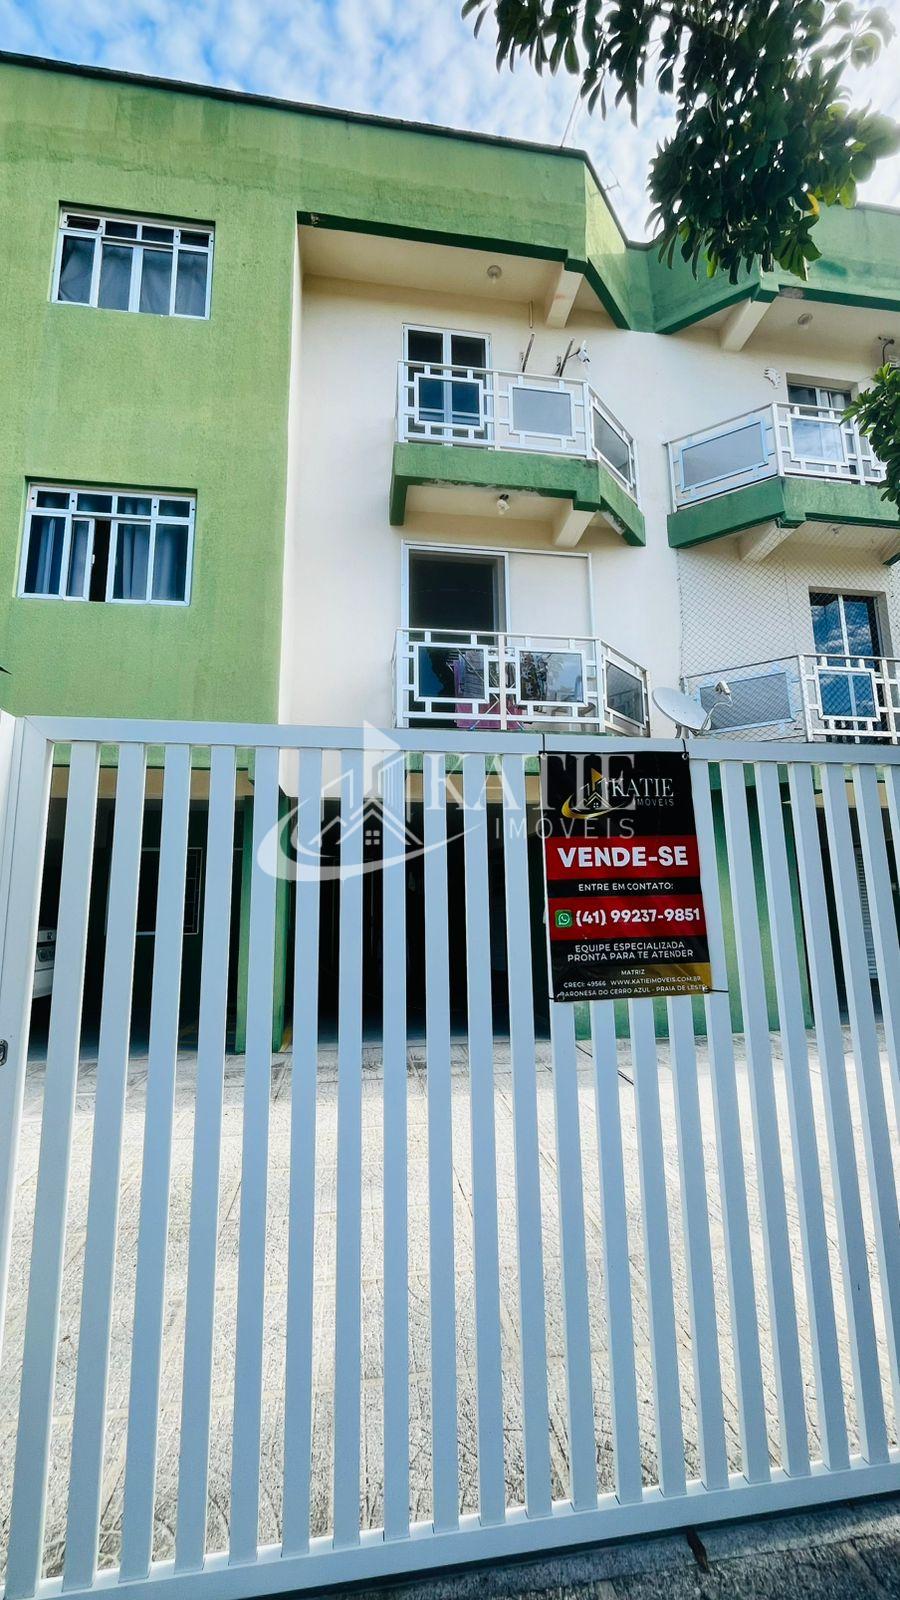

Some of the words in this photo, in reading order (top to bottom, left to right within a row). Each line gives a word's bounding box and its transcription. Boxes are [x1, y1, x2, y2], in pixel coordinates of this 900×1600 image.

[612, 778, 675, 797] KATIE
[557, 845, 689, 868] VENDE-SE
[578, 883, 609, 892] ENTRE
[612, 883, 626, 891] EM
[627, 881, 674, 891] CONTATO:
[575, 909, 607, 927] (41)
[610, 907, 701, 924] 99237-9851
[575, 943, 611, 953] EQUIPE
[613, 941, 685, 951] ESPECIALIZADA
[567, 953, 607, 963] PRONTA
[609, 951, 636, 961] PARA
[637, 950, 649, 960] TE
[651, 949, 694, 959] ATENDER
[610, 975, 702, 986] WWW.KATIEIMOVEIS.COM.BR
